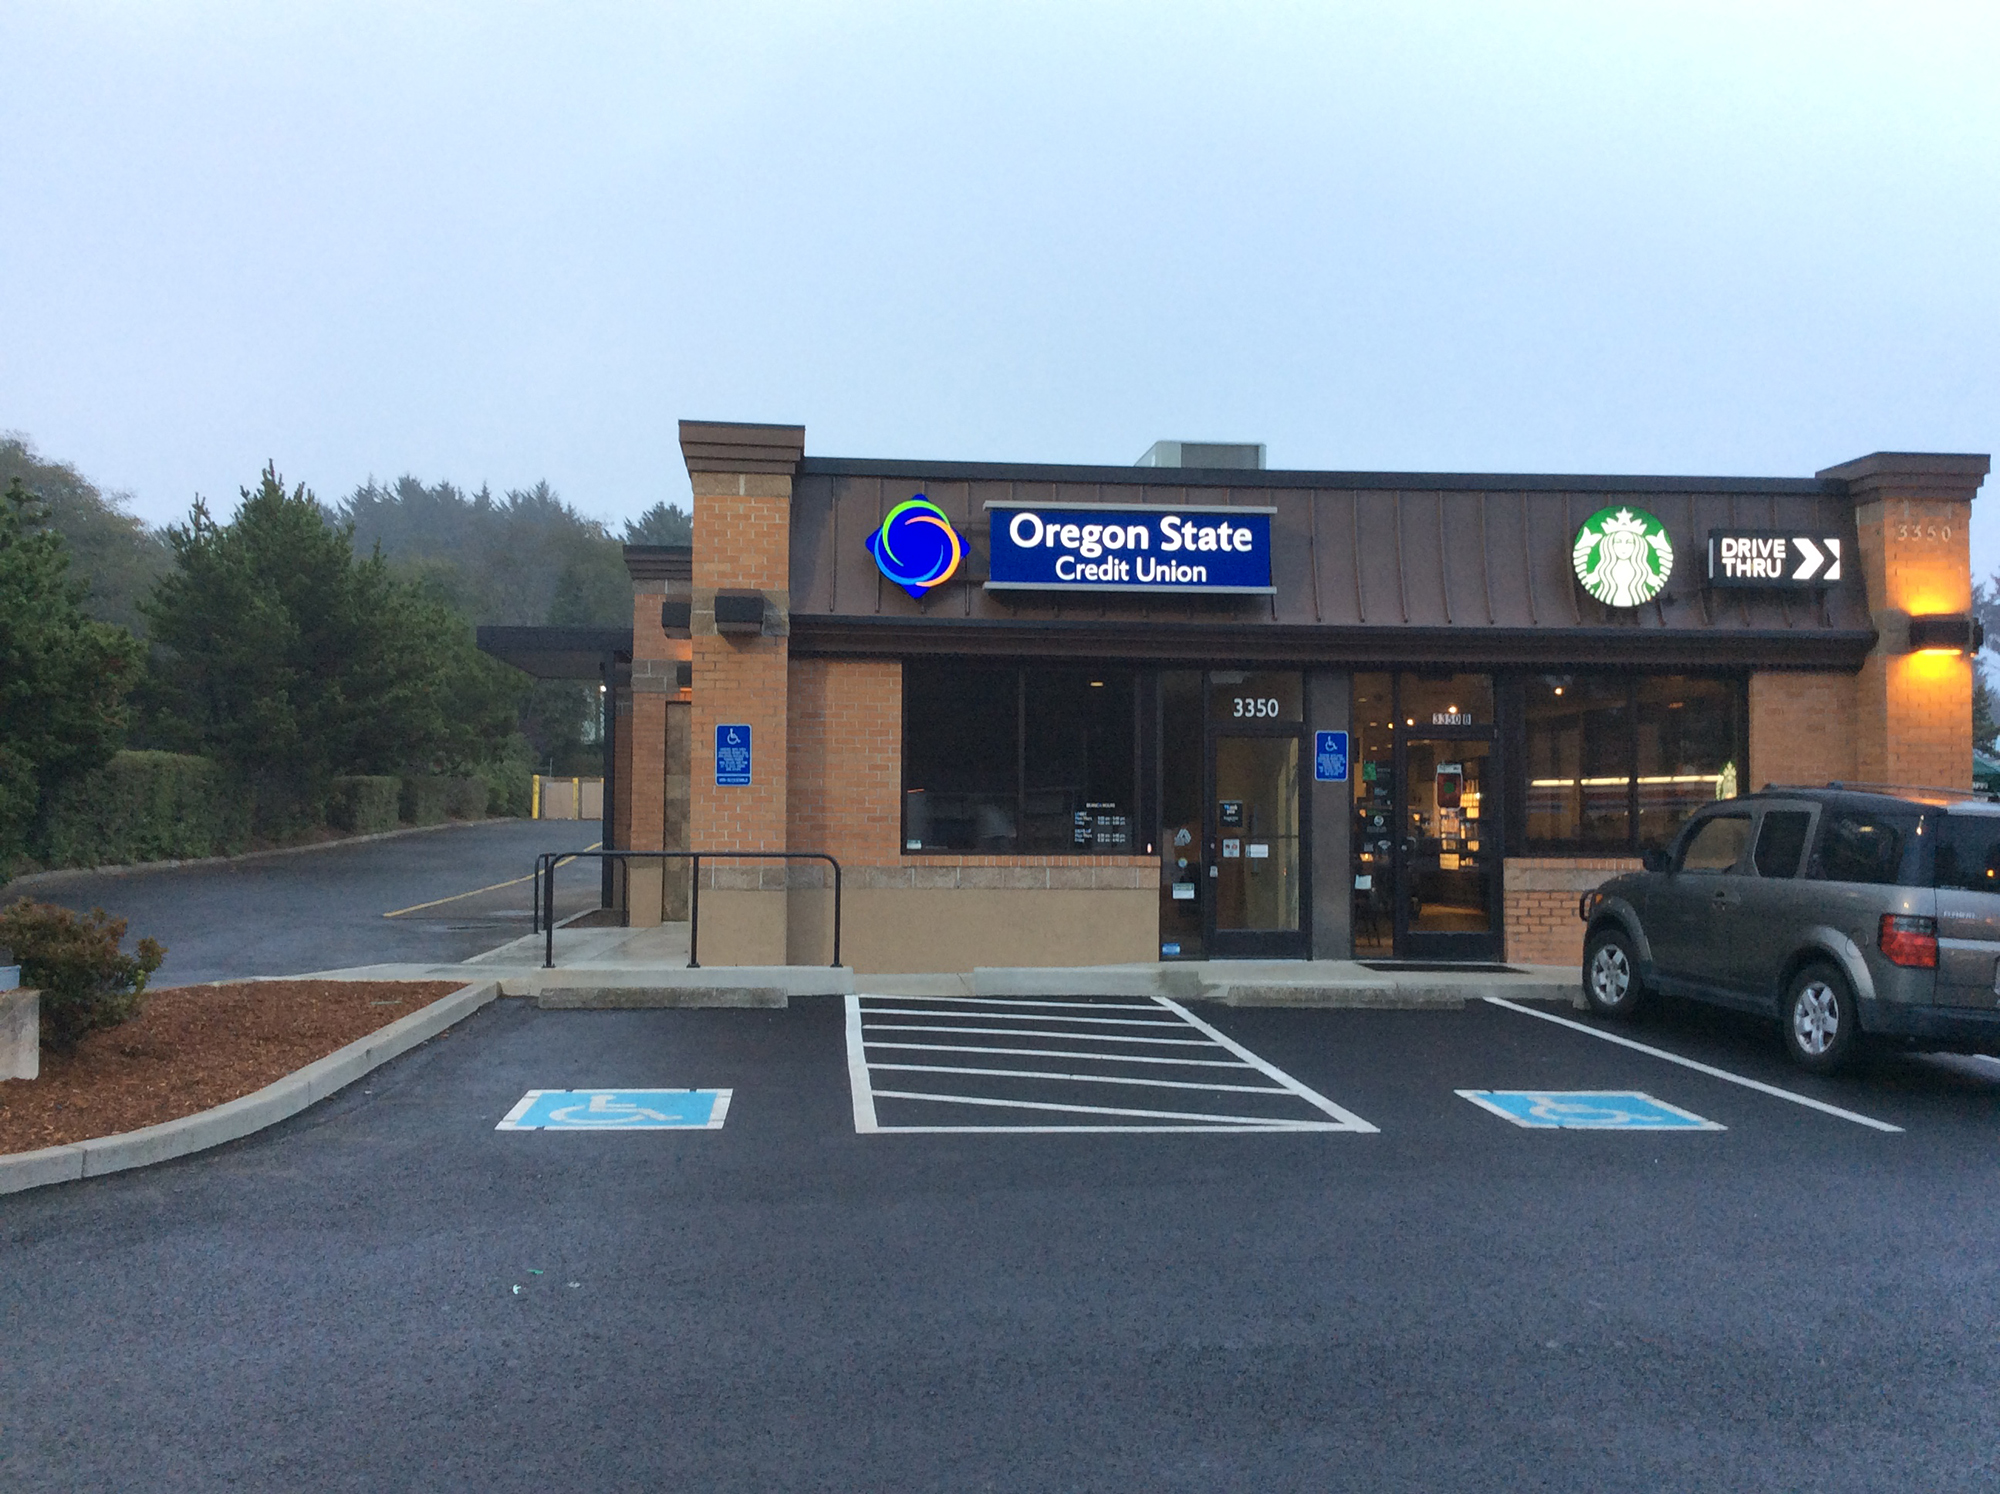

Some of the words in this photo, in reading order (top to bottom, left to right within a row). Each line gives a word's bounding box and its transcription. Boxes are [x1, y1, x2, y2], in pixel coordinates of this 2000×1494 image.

[1009, 512, 1149, 558] Oregon
[1160, 515, 1253, 552] State
[1898, 524, 1952, 542] 3350
[1721, 538, 1786, 558] DRIVE
[1055, 555, 1130, 581] Credit
[1136, 556, 1207, 582] Union
[1721, 558, 1782, 578] THRU
[1233, 698, 1279, 718] 3350
